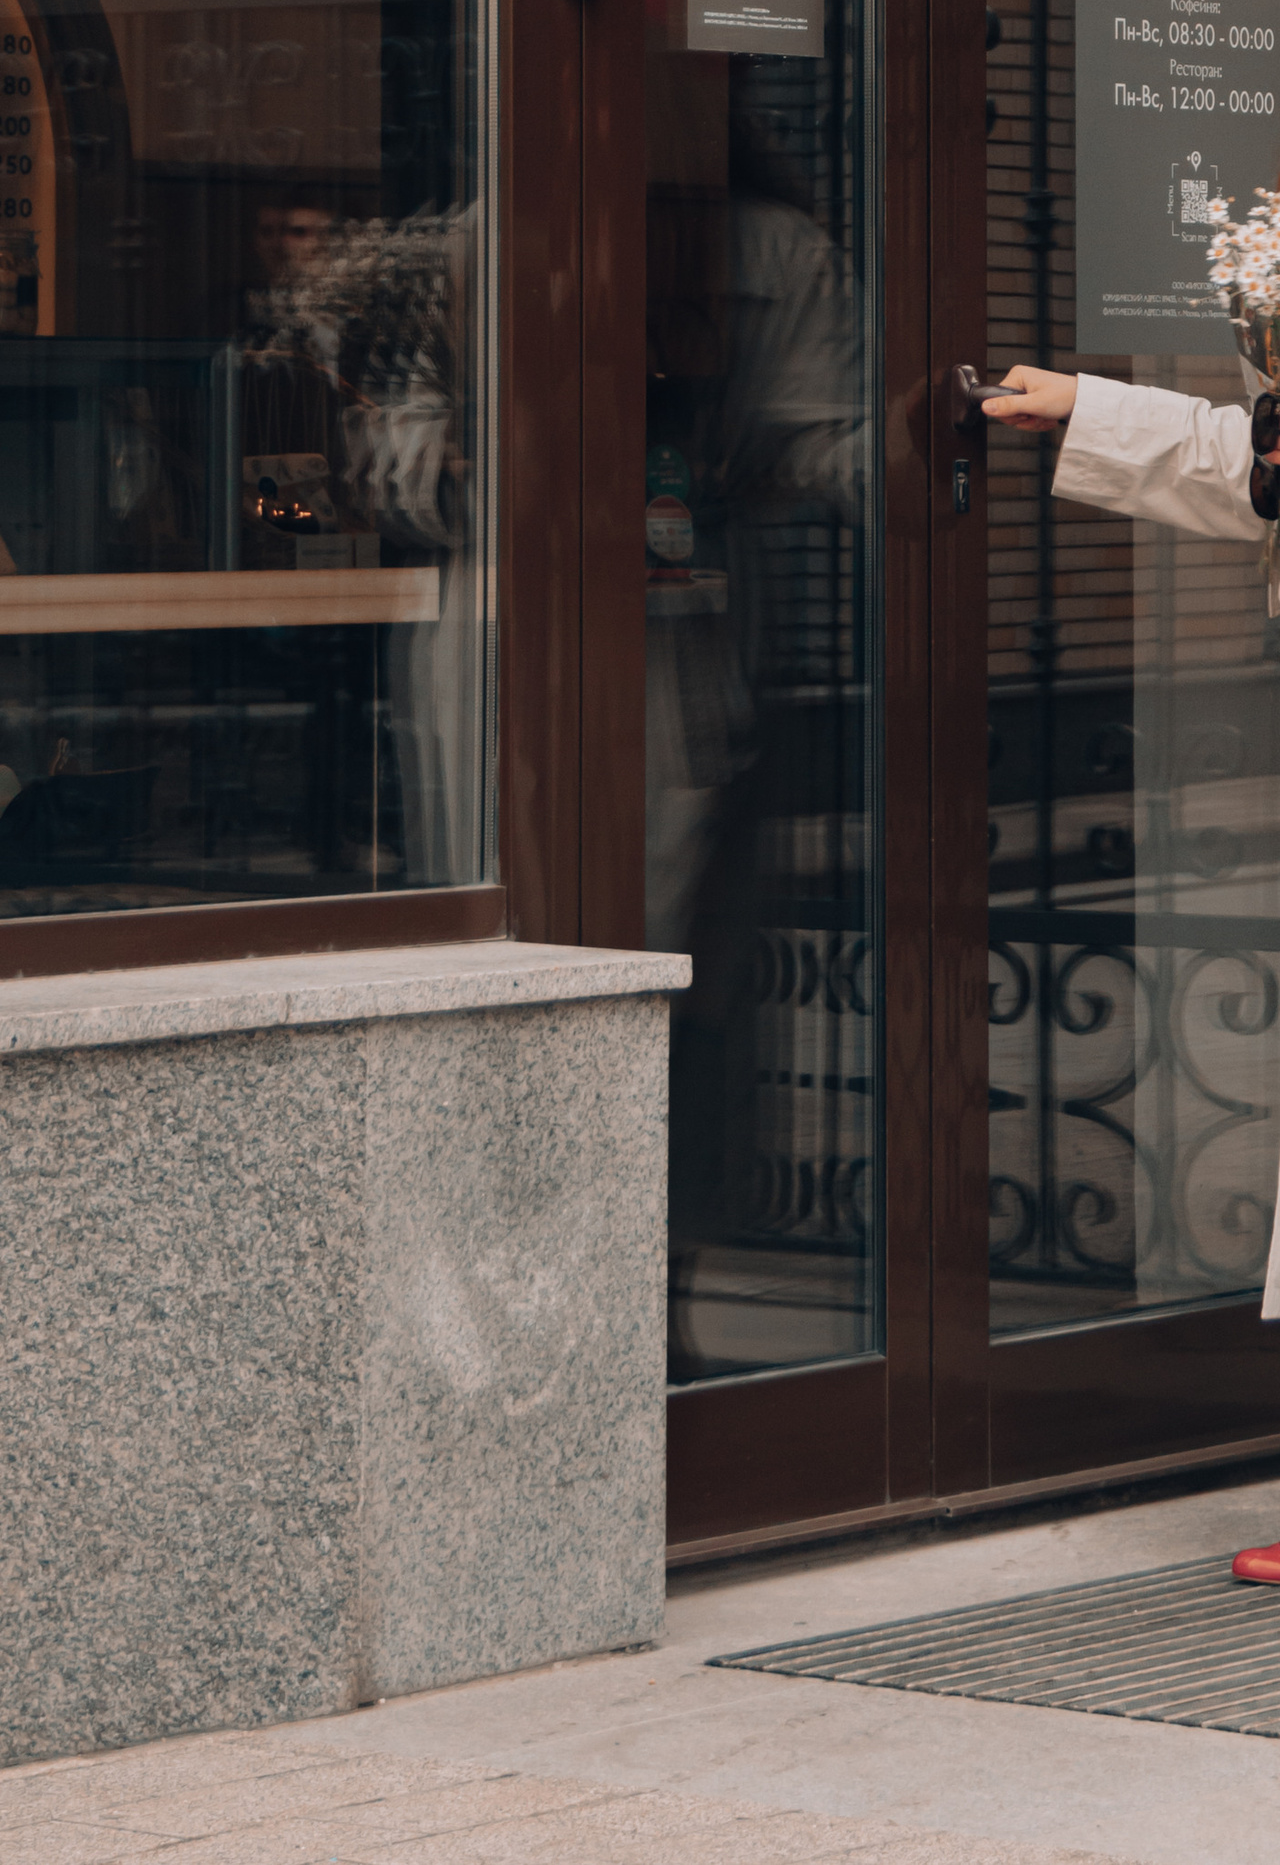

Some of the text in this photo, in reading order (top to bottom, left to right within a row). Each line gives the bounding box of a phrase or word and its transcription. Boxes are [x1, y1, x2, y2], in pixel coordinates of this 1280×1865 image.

[1114, 17, 1164, 47] Пн-Вс,
[1168, 21, 1215, 47] 08:30
[1229, 25, 1275, 51] 00:00
[1170, 58, 1223, 82] Ресторан:
[1114, 83, 1164, 112] Пн-Вс,
[1171, 86, 1215, 112] 12:00
[1229, 89, 1275, 114] 00:00
[0, 197, 33, 218] 80
[1181, 231, 1208, 242] Scan me
[1172, 281, 1185, 290] ООО
